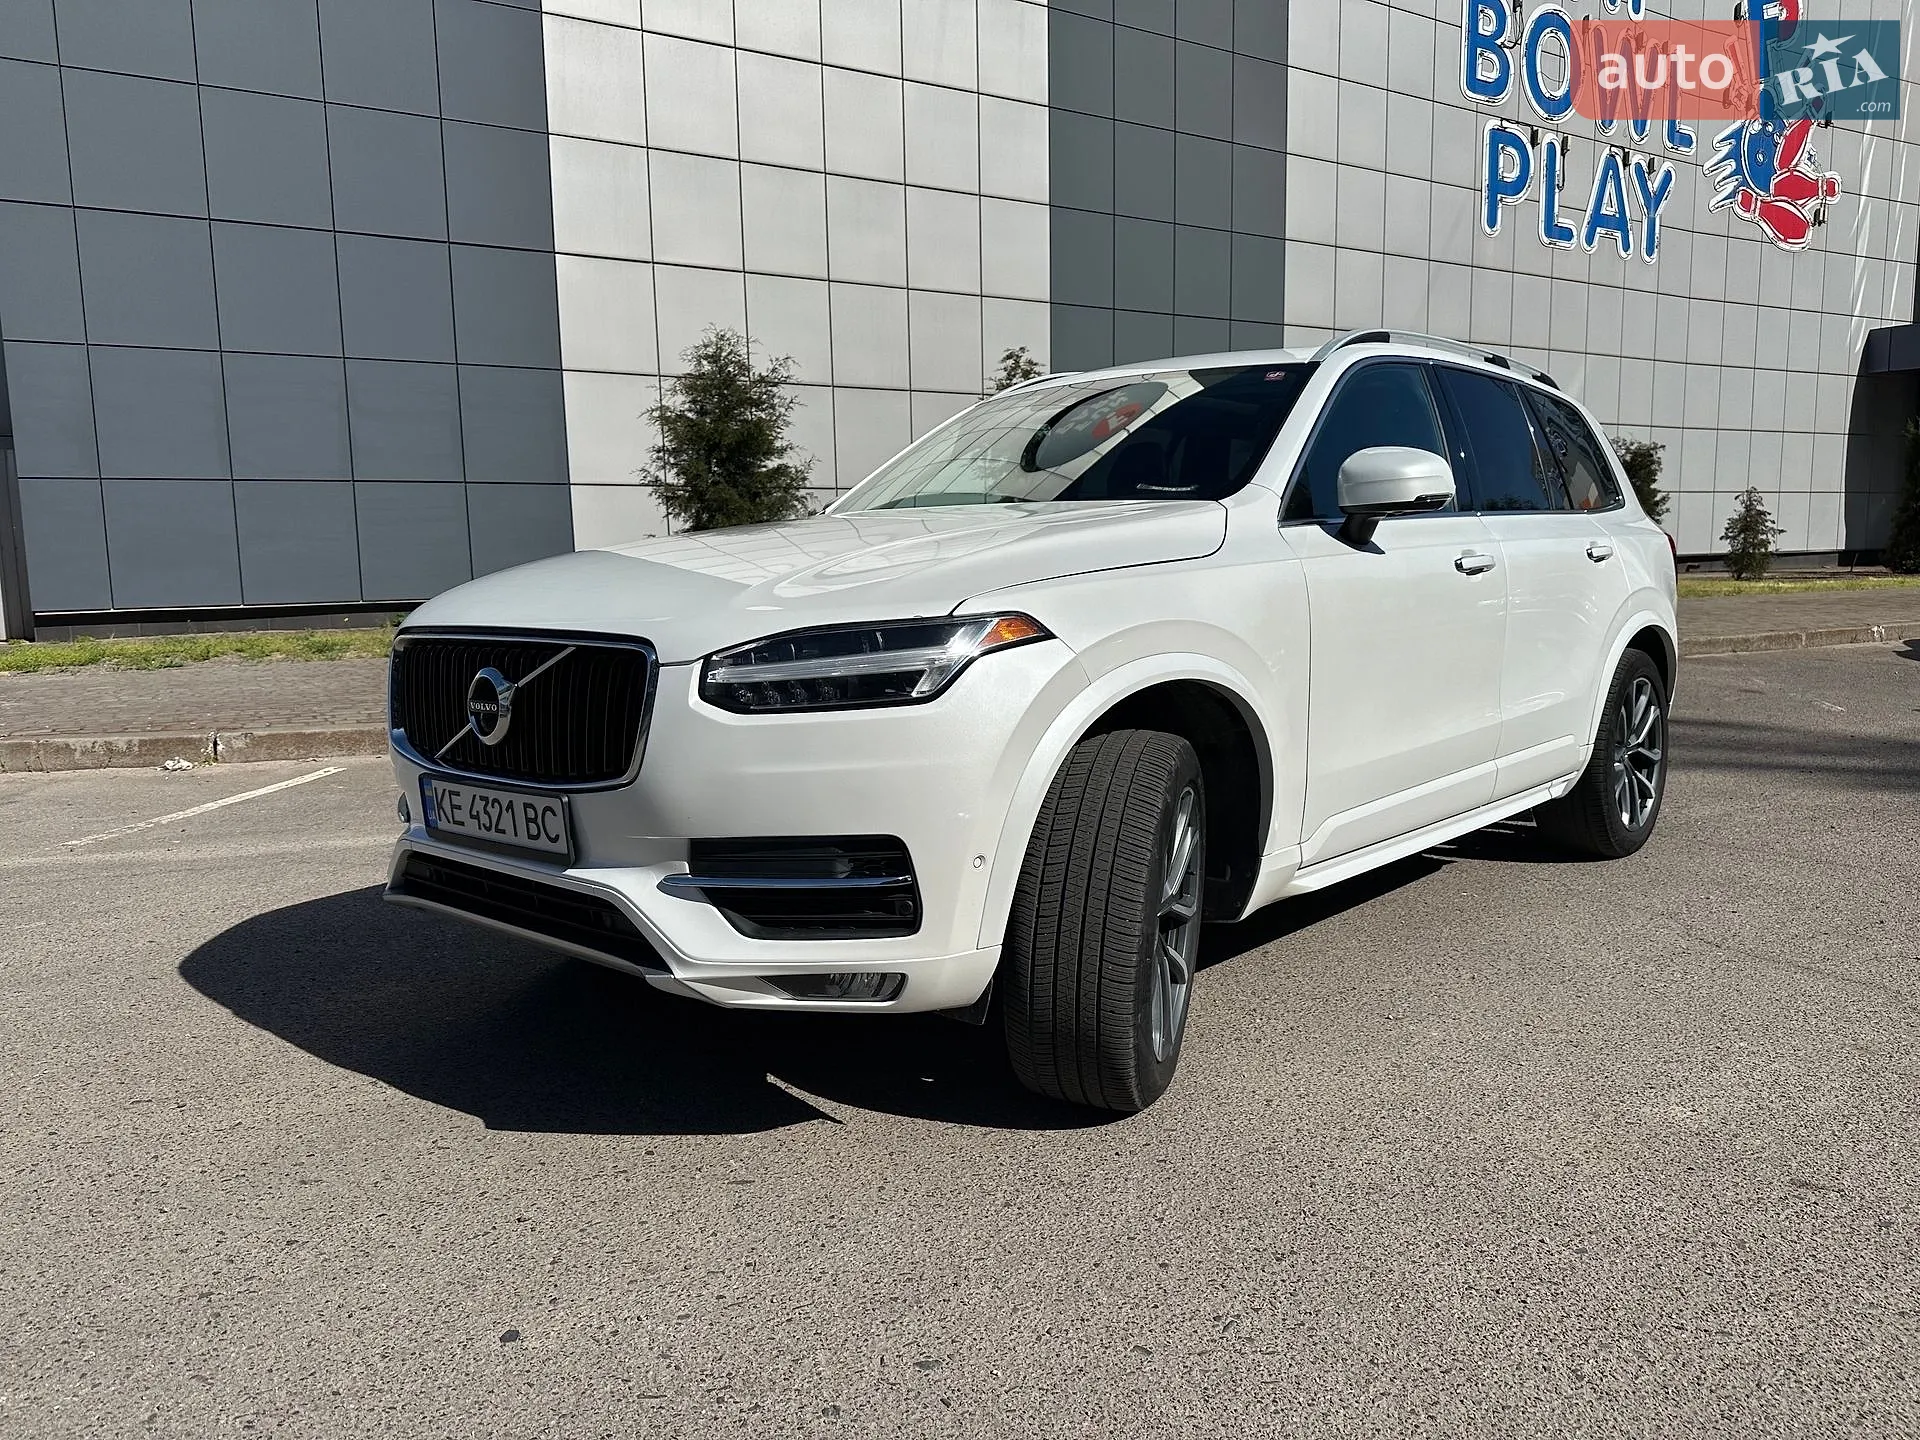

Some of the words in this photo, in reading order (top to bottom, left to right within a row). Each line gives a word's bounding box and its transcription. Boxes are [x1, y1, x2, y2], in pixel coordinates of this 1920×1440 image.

[1461, 0, 1697, 155] BOWL
[1481, 119, 1676, 264] PLAY
[470, 701, 497, 711] VOLVO
[433, 786, 465, 827] KE
[469, 793, 518, 837] 4321
[523, 802, 560, 843] BC
